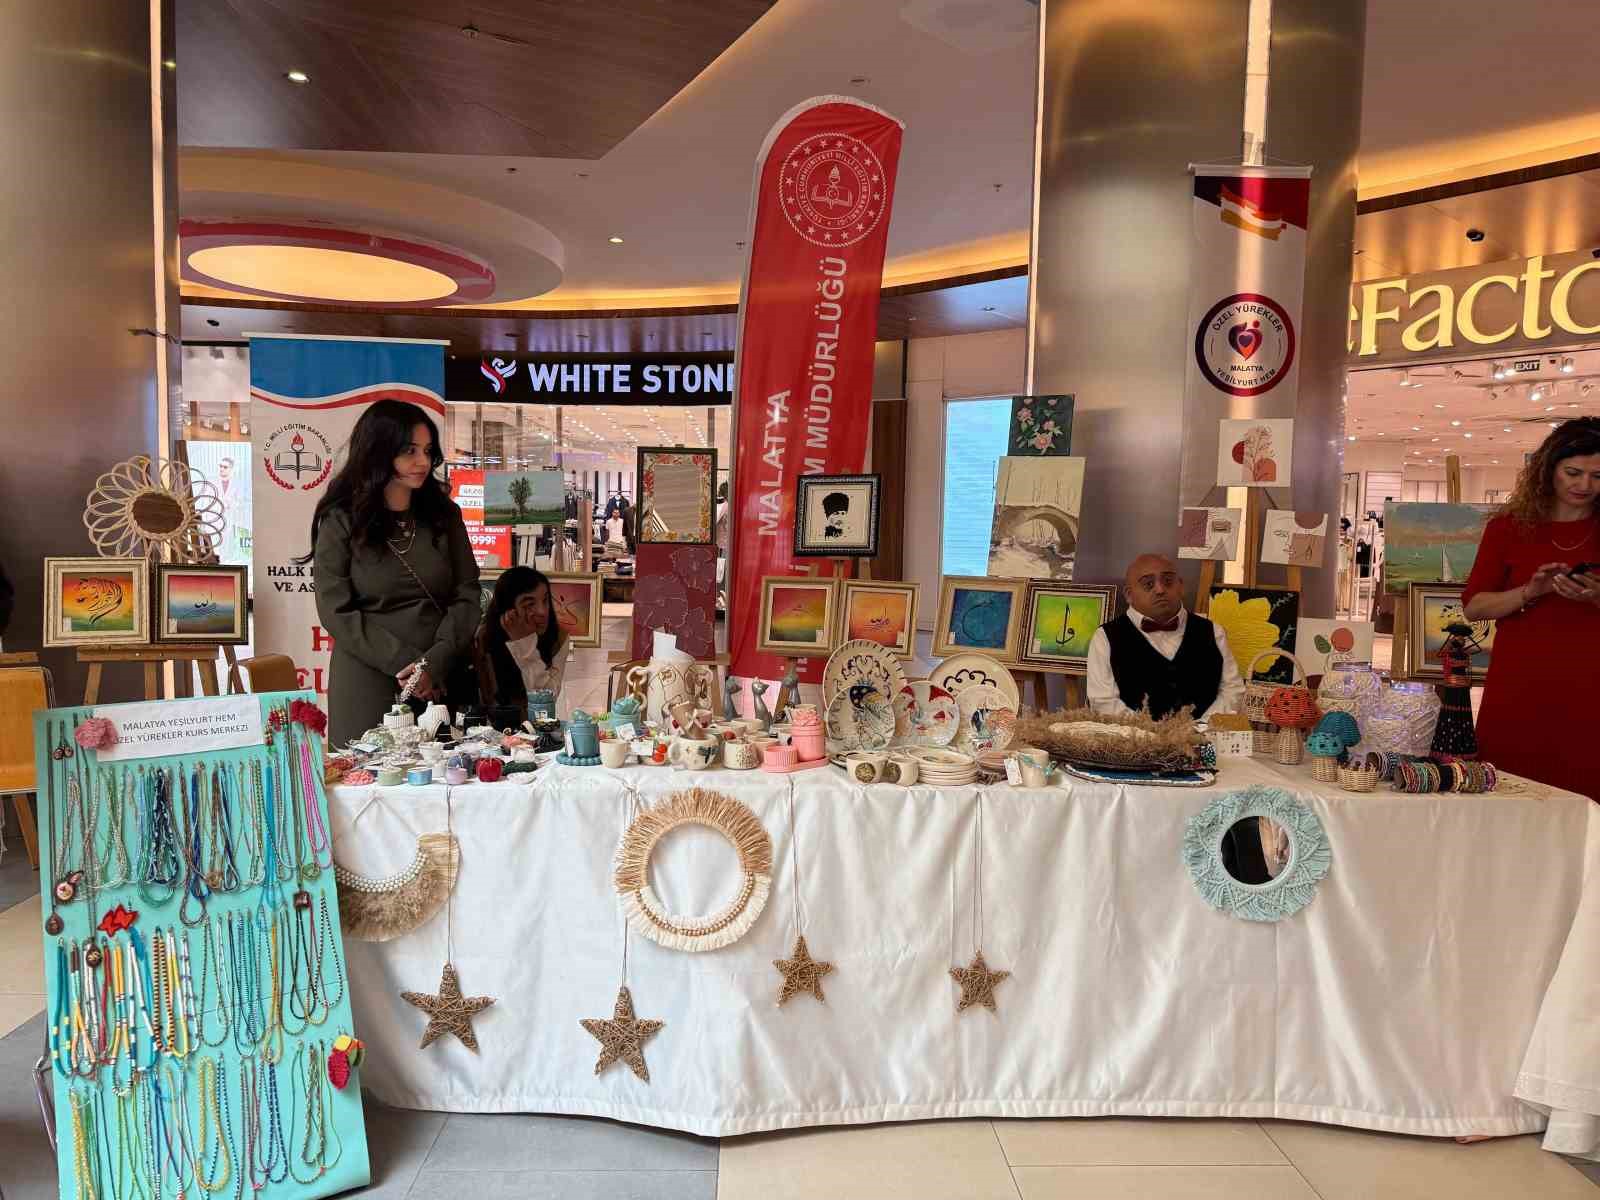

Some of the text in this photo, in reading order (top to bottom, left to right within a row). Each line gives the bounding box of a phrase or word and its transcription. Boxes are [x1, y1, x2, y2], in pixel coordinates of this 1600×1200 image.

[1236, 303, 1283, 333] YÜREKLER
[803, 256, 848, 449] MÜDÜRLÜĞÜ
[1515, 361, 1538, 371] EXIT
[528, 363, 631, 393] WHITE
[758, 389, 792, 537] MALATYA
[267, 565, 306, 578] HALK
[273, 581, 294, 593] VE
[122, 712, 237, 732] MALATYA YEŞİLYURT HEM
[136, 731, 184, 743] YÜREKLER
[185, 727, 209, 738] KURS
[210, 723, 249, 735] MERKEZİ
